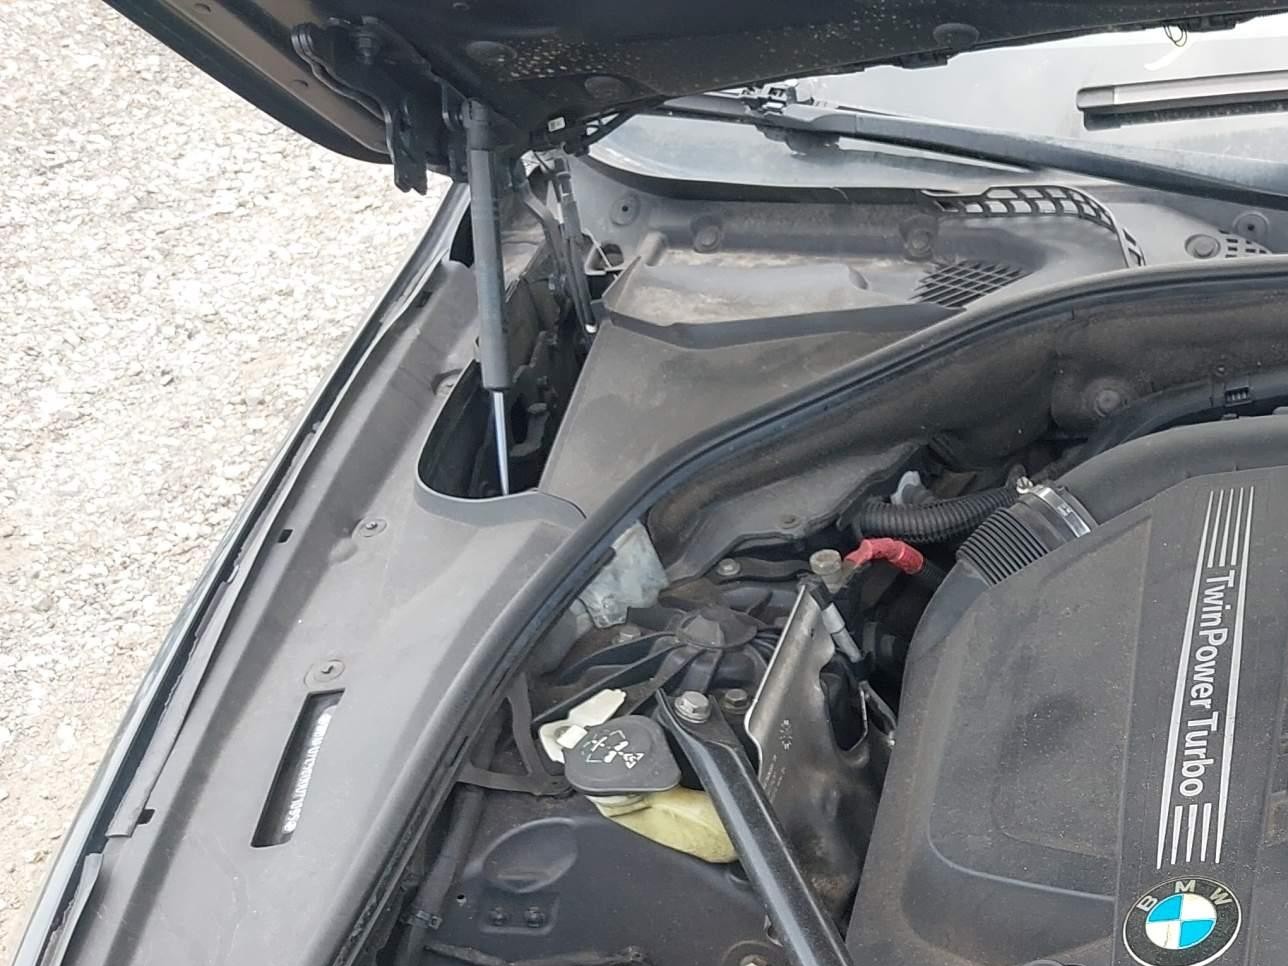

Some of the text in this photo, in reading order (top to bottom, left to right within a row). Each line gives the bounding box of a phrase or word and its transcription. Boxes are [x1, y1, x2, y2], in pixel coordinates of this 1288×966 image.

[1180, 570, 1235, 796] TwinPower Turbo
[1136, 879, 1233, 912] BMW
